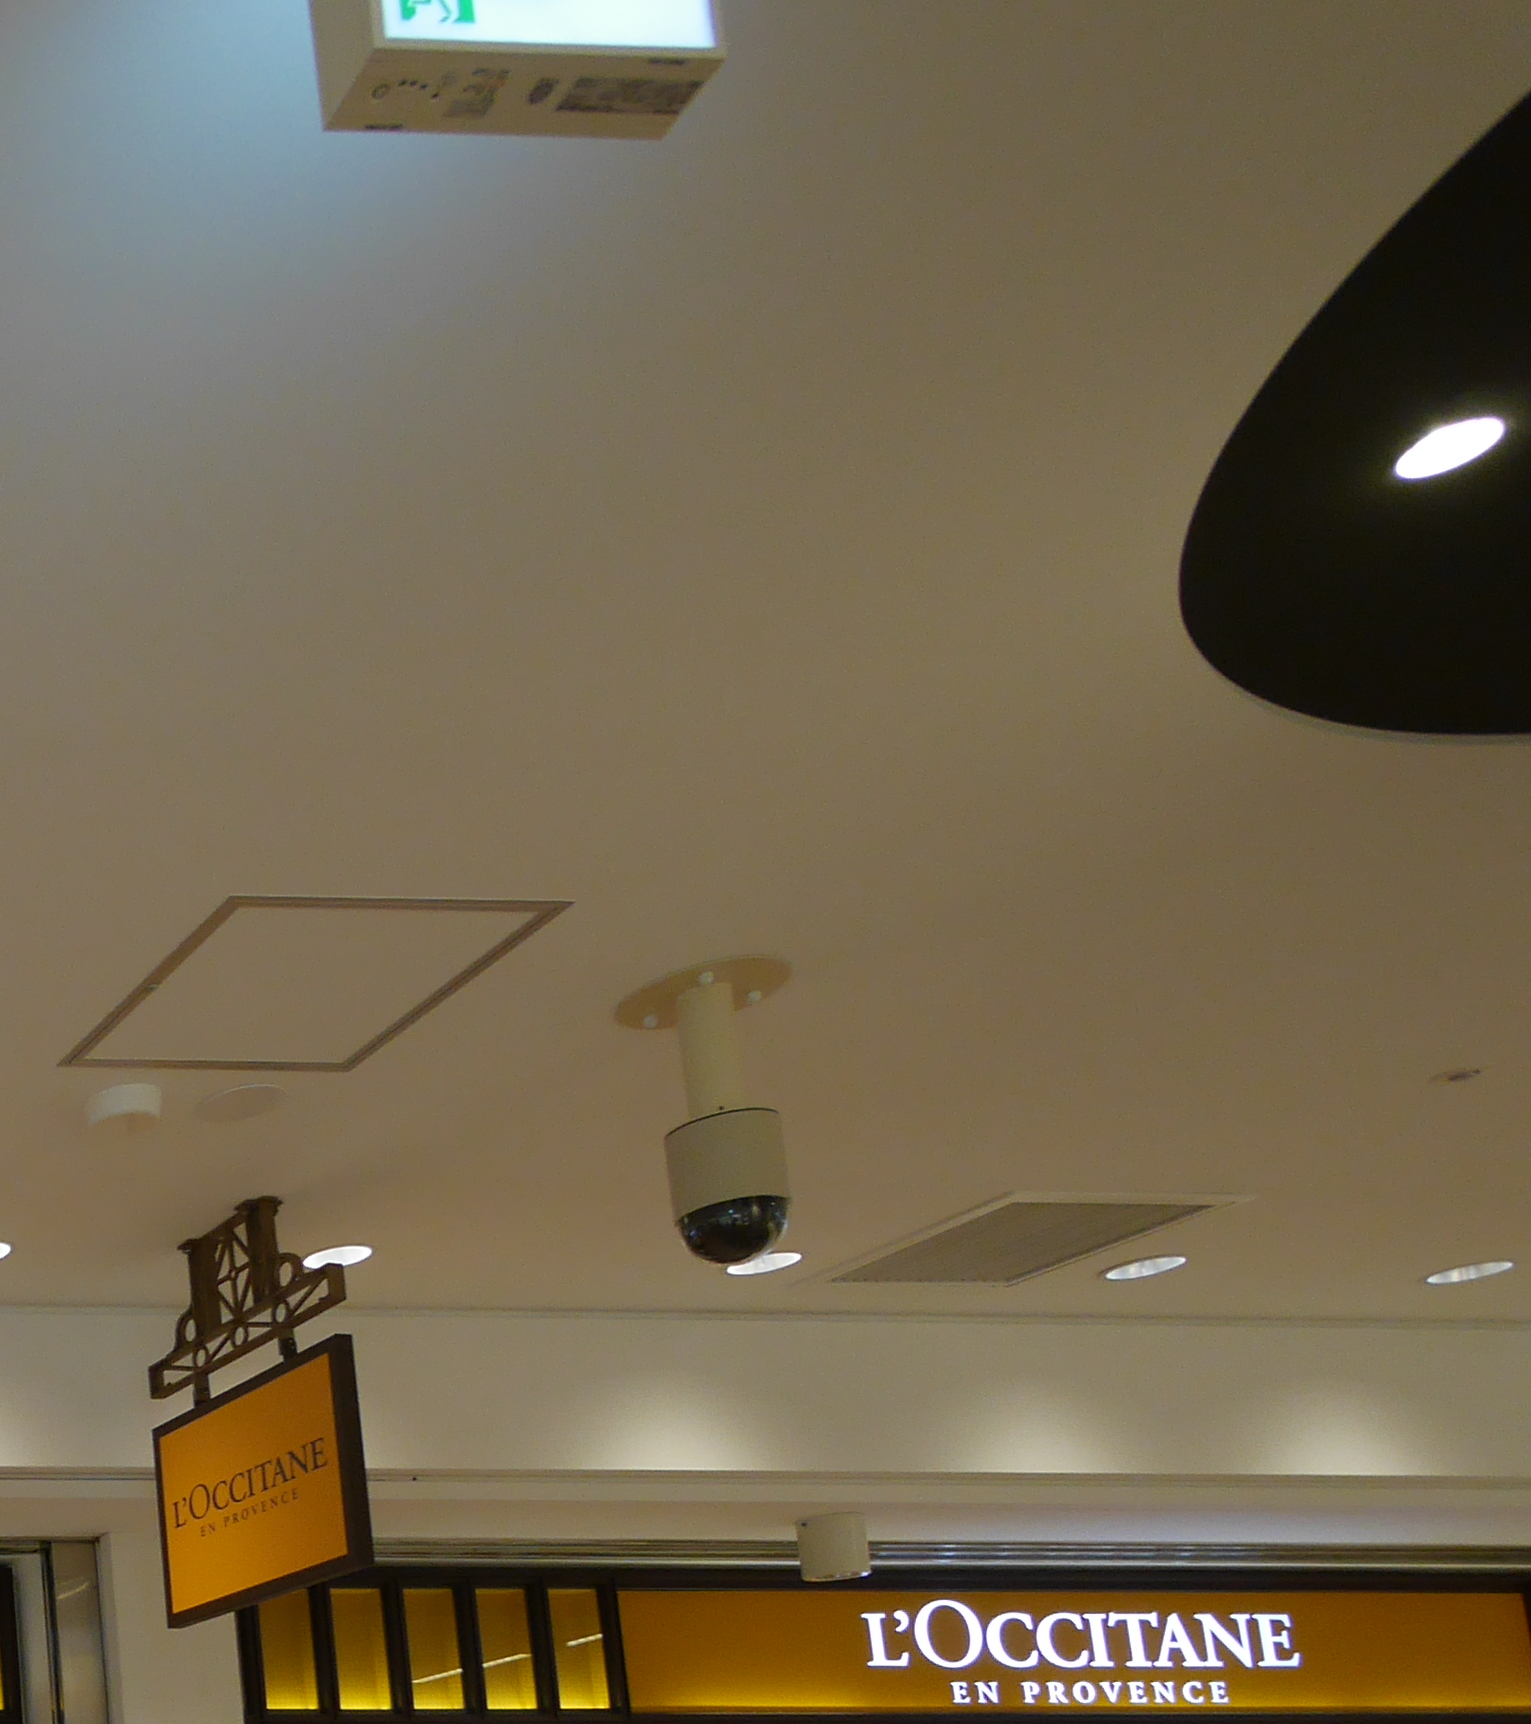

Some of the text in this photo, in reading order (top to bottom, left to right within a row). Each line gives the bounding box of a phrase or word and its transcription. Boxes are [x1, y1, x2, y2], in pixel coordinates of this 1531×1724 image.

[172, 1437, 328, 1529] L'OCCITANE
[200, 1487, 300, 1537] EN PROVENCE
[860, 1599, 1301, 1669] L'OCCITANE
[949, 1680, 1230, 1704] EN PROVENCE
